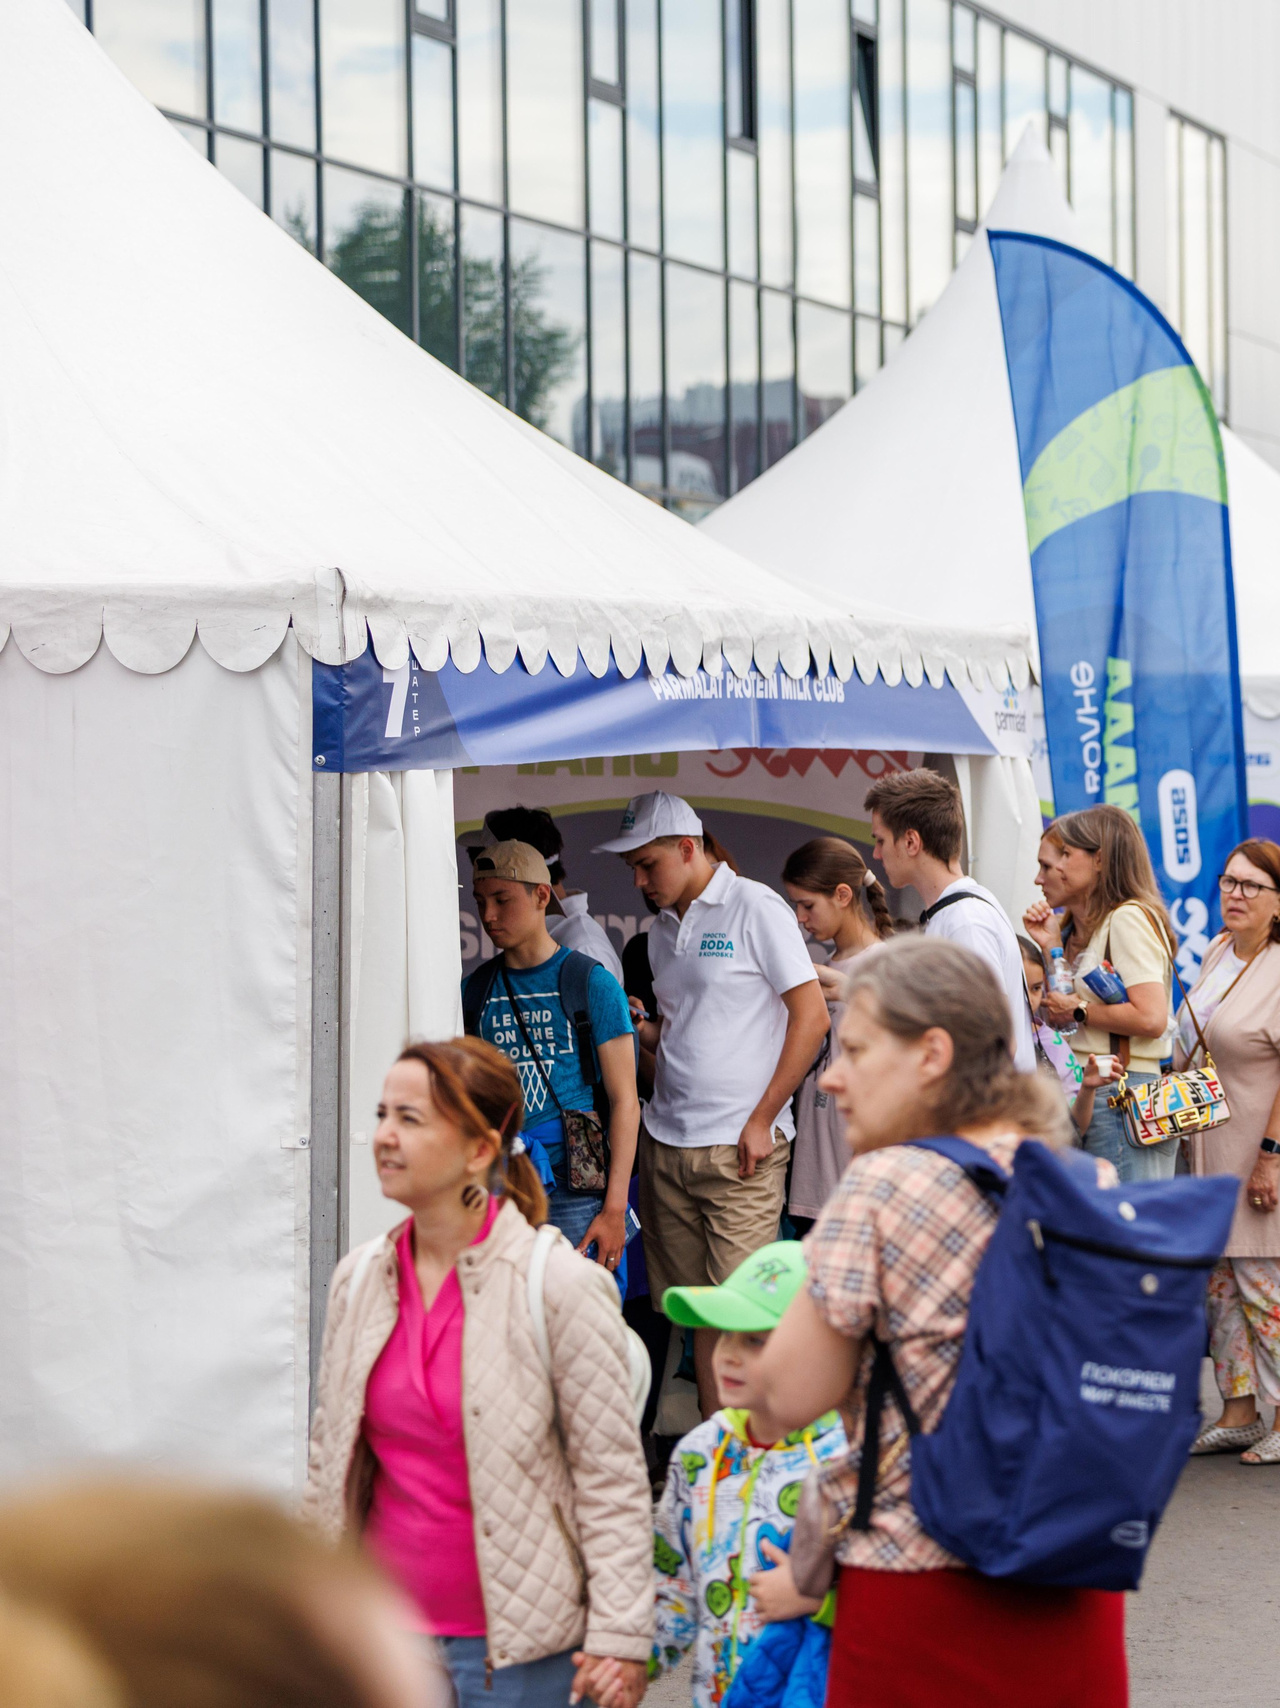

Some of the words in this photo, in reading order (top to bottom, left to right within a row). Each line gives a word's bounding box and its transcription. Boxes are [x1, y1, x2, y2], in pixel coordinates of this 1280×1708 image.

[382, 660, 410, 738] 7
[411, 659, 421, 737] ШАТЕР
[648, 672, 725, 701] PARMALAT
[726, 671, 778, 700] PROTEIN
[781, 673, 812, 701] MILK
[813, 675, 845, 703] CLUB
[703, 951, 733, 959] КОРОБКЕ
[494, 1030, 517, 1044] ON
